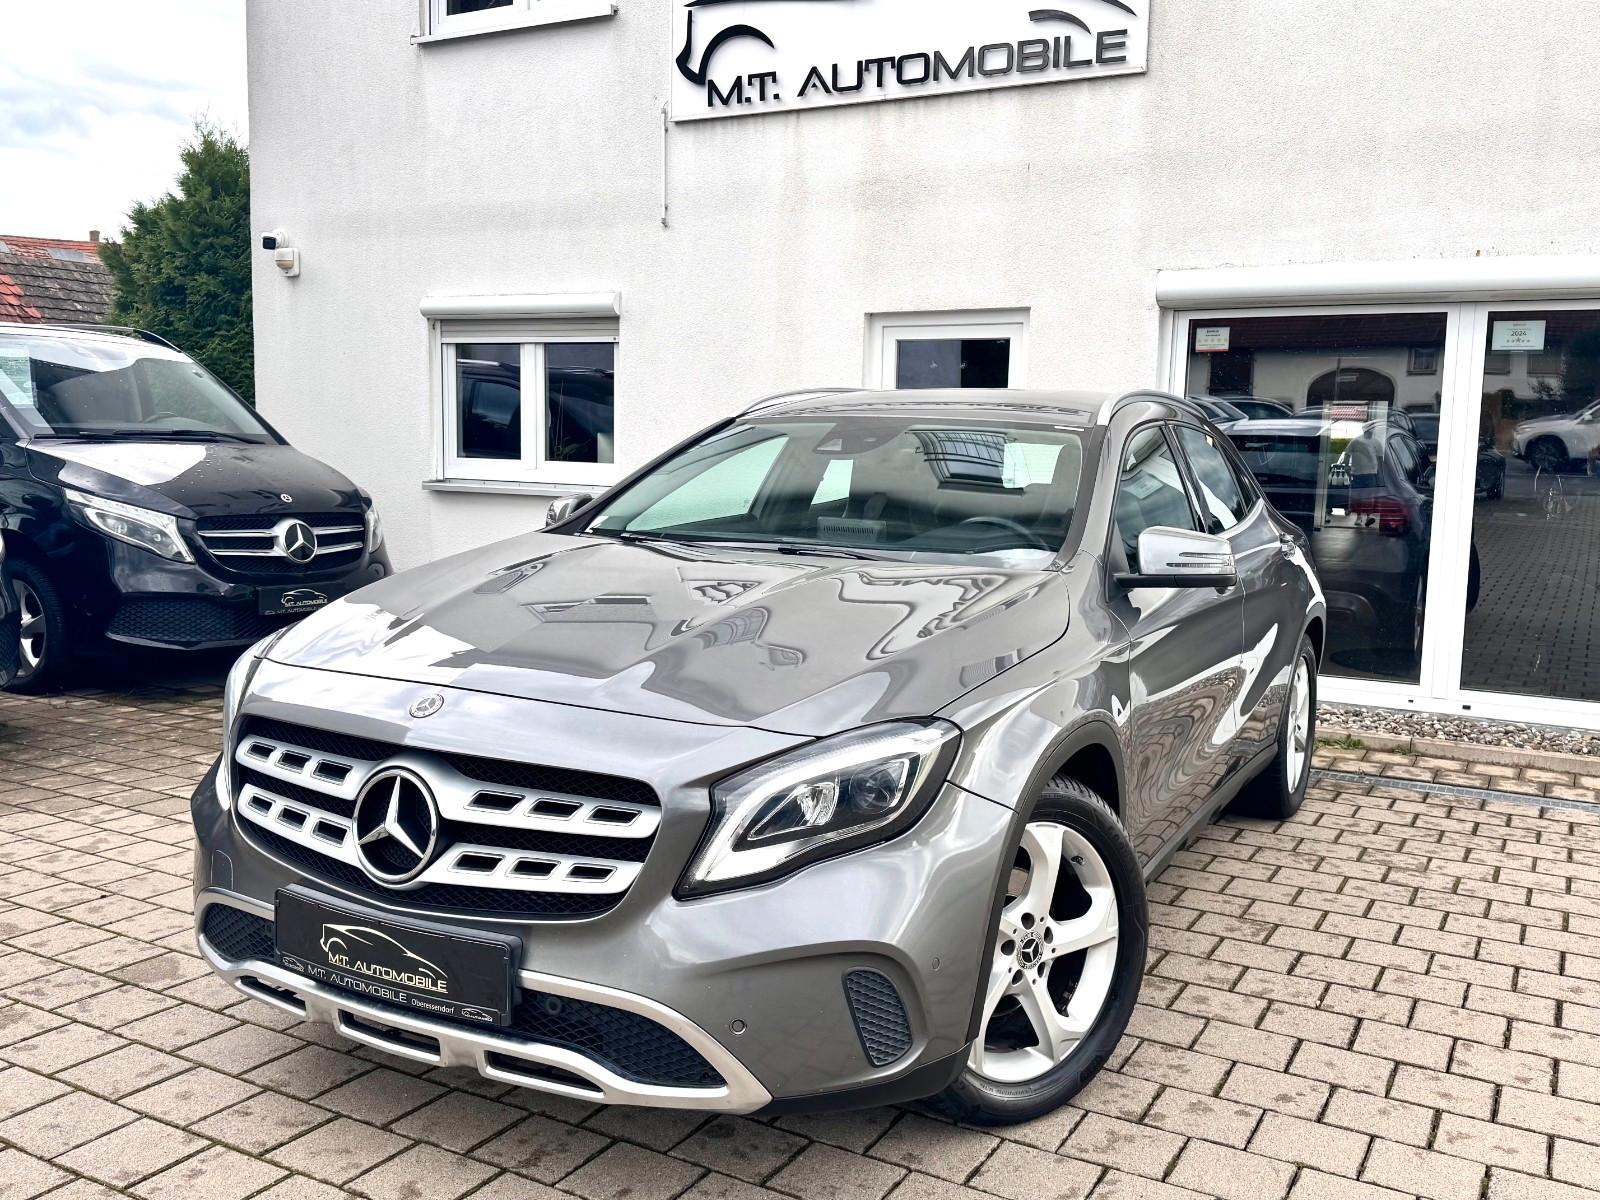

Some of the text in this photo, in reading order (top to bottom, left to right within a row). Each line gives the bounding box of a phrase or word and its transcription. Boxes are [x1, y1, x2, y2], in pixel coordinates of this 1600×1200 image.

[707, 28, 1128, 107] M.T. AUTOMOBILE
[307, 964, 327, 980] M.T.
[330, 974, 408, 1003] AUTOMOBILE
[411, 998, 455, 1015] Oberessendorf
[328, 951, 448, 992] M.T. AUTOMOBILE
